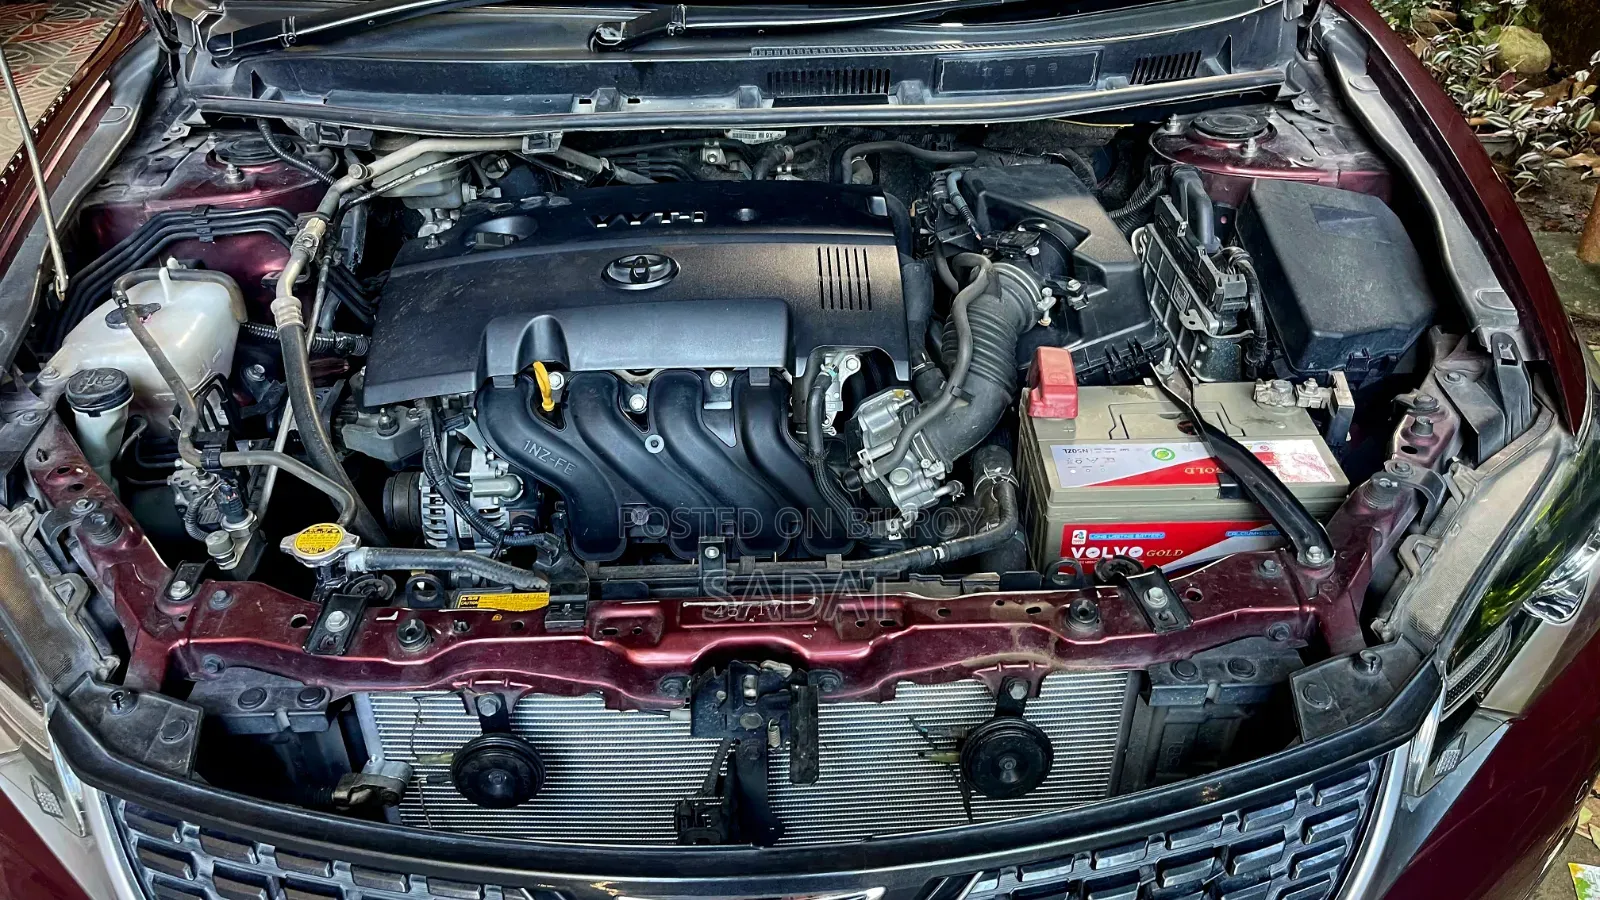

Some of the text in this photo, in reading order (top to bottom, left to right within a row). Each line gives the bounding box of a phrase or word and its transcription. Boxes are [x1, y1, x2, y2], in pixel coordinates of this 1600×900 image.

[523, 440, 577, 476] 1NZ-FE
[1071, 546, 1184, 559] VOLVO GOLD
